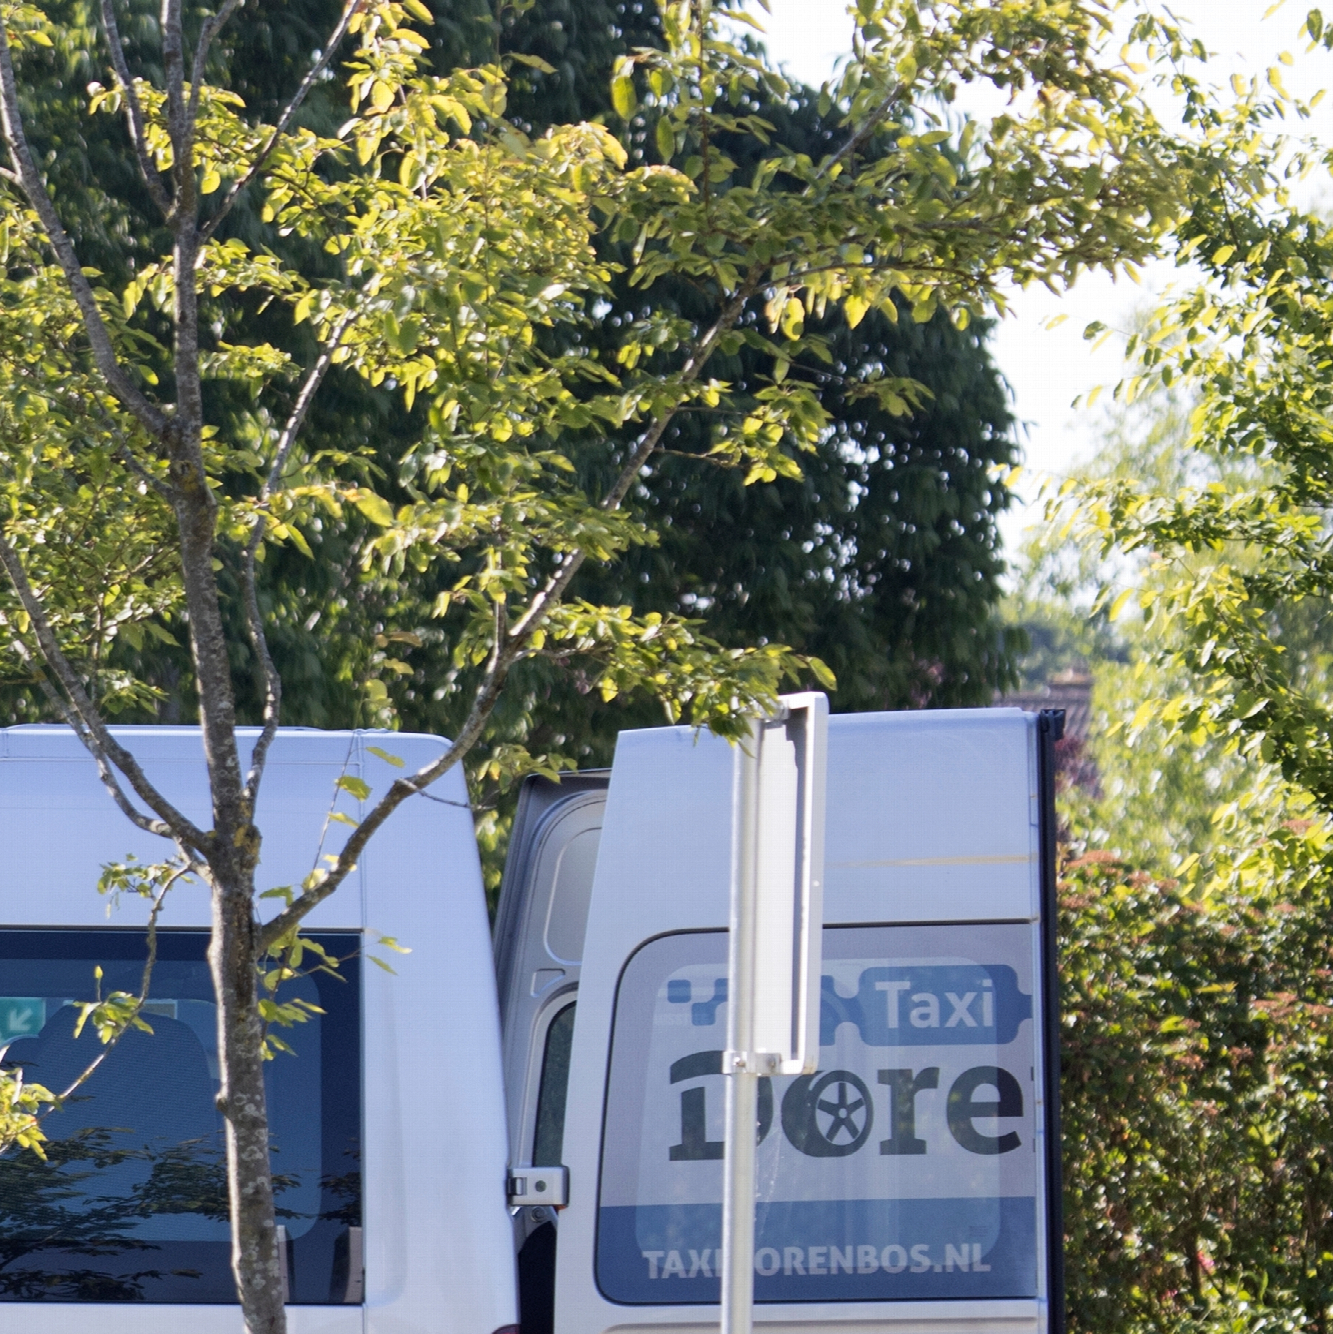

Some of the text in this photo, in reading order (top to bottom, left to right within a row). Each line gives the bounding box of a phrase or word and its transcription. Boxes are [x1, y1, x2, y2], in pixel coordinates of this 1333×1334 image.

[875, 979, 993, 1028] Taxi
[669, 1050, 1035, 1162] Dore
[642, 1244, 991, 1279] TAXIORENBOS.NL
